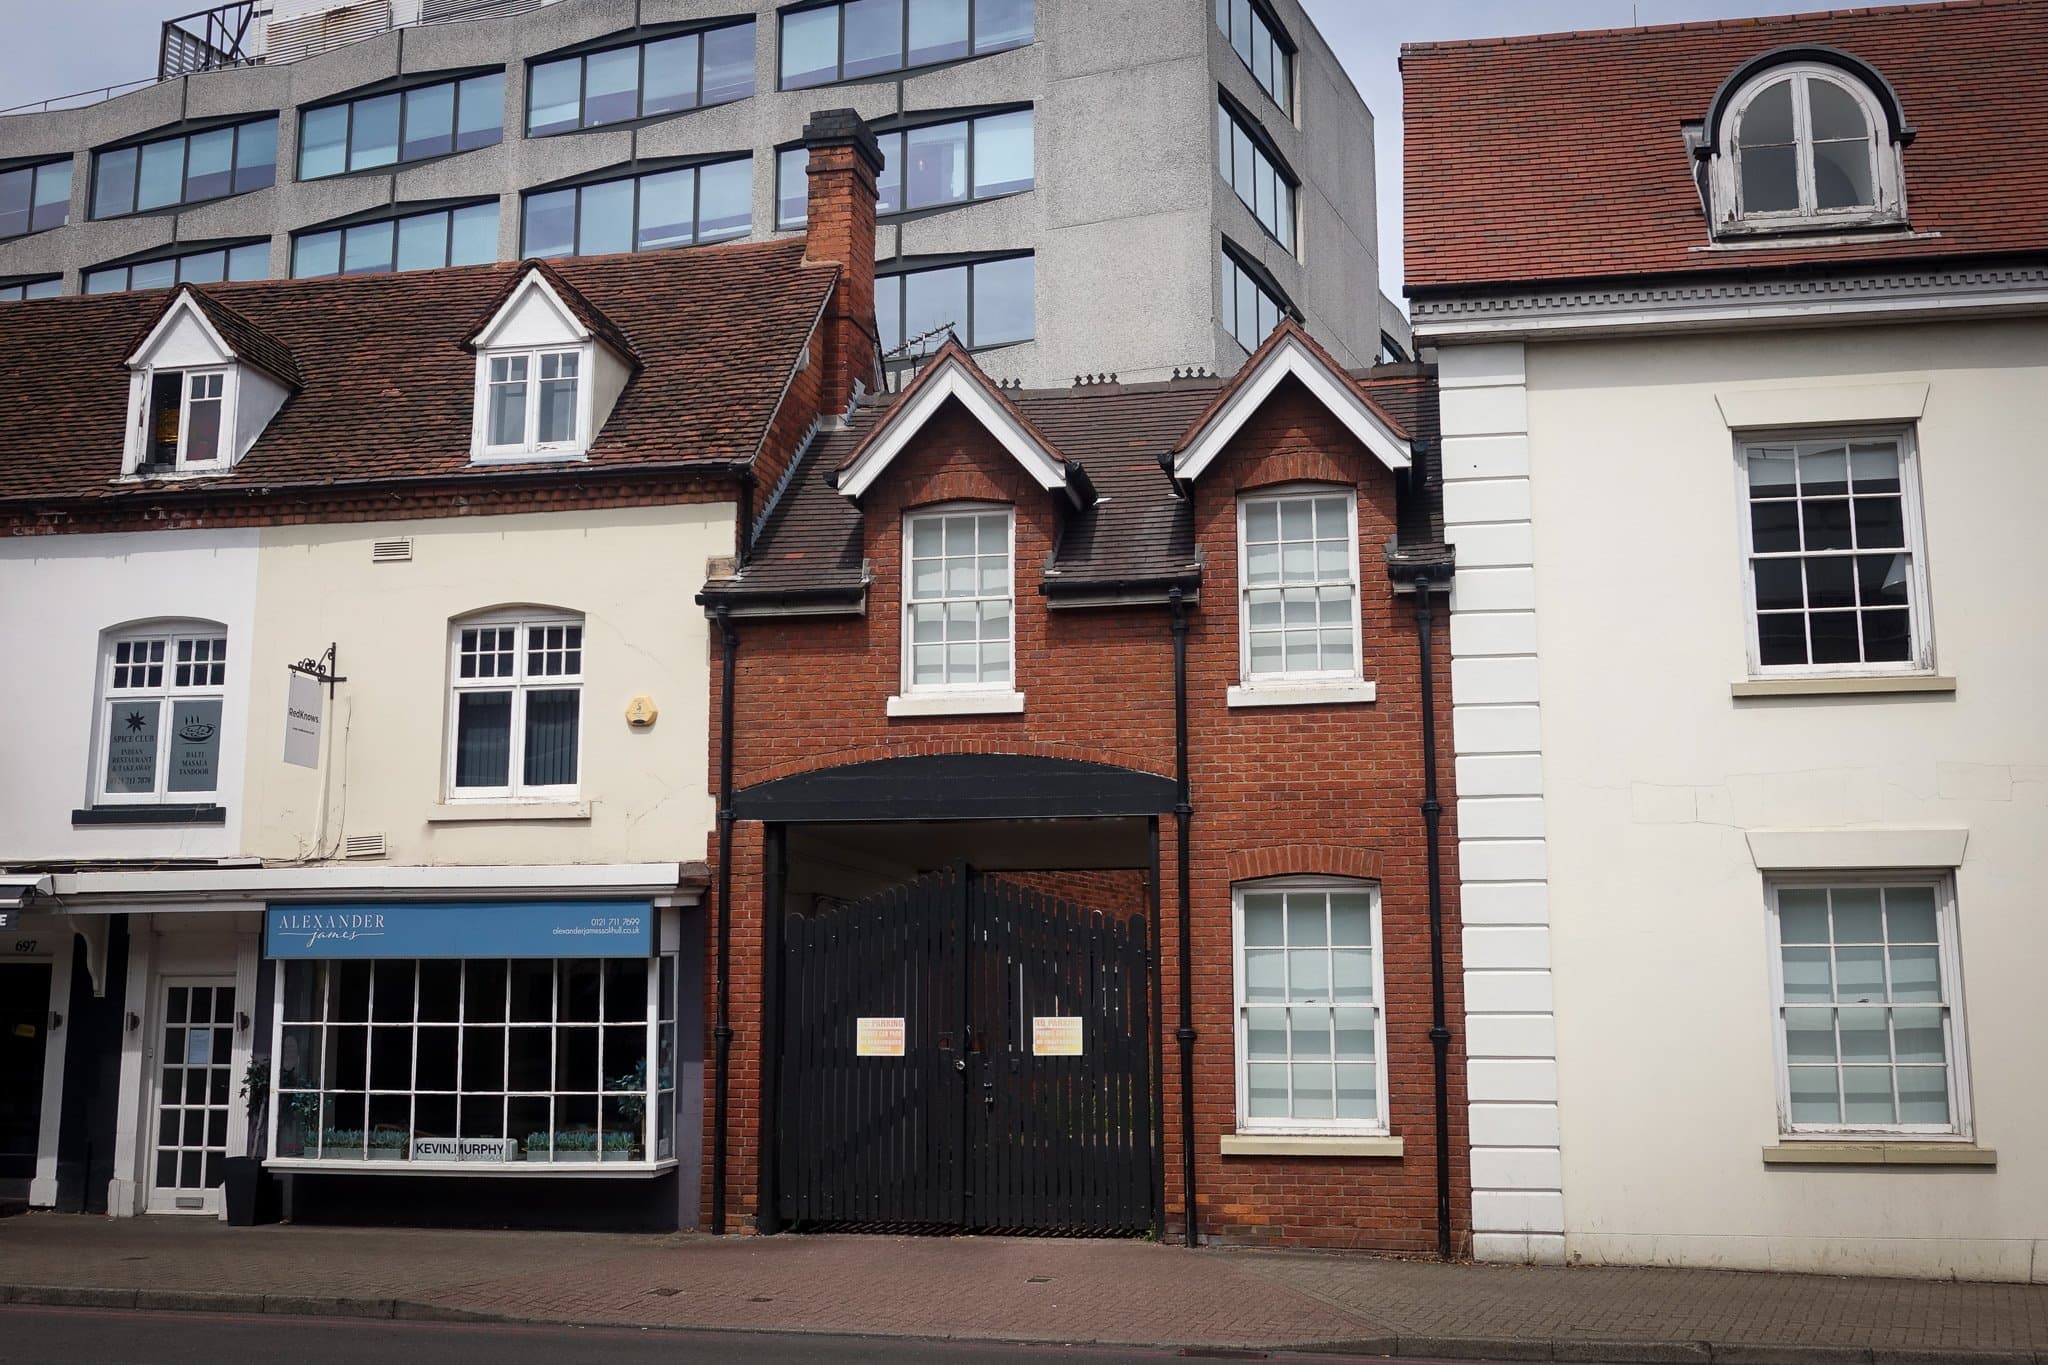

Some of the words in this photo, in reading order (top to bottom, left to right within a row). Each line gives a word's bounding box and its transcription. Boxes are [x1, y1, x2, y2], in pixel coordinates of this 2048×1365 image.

[289, 707, 319, 723] RedKnows
[279, 914, 385, 929] ALEXANDER
[591, 918, 606, 926] 0121
[608, 918, 619, 926] 711
[15, 940, 37, 952] 697
[306, 929, 359, 948] james
